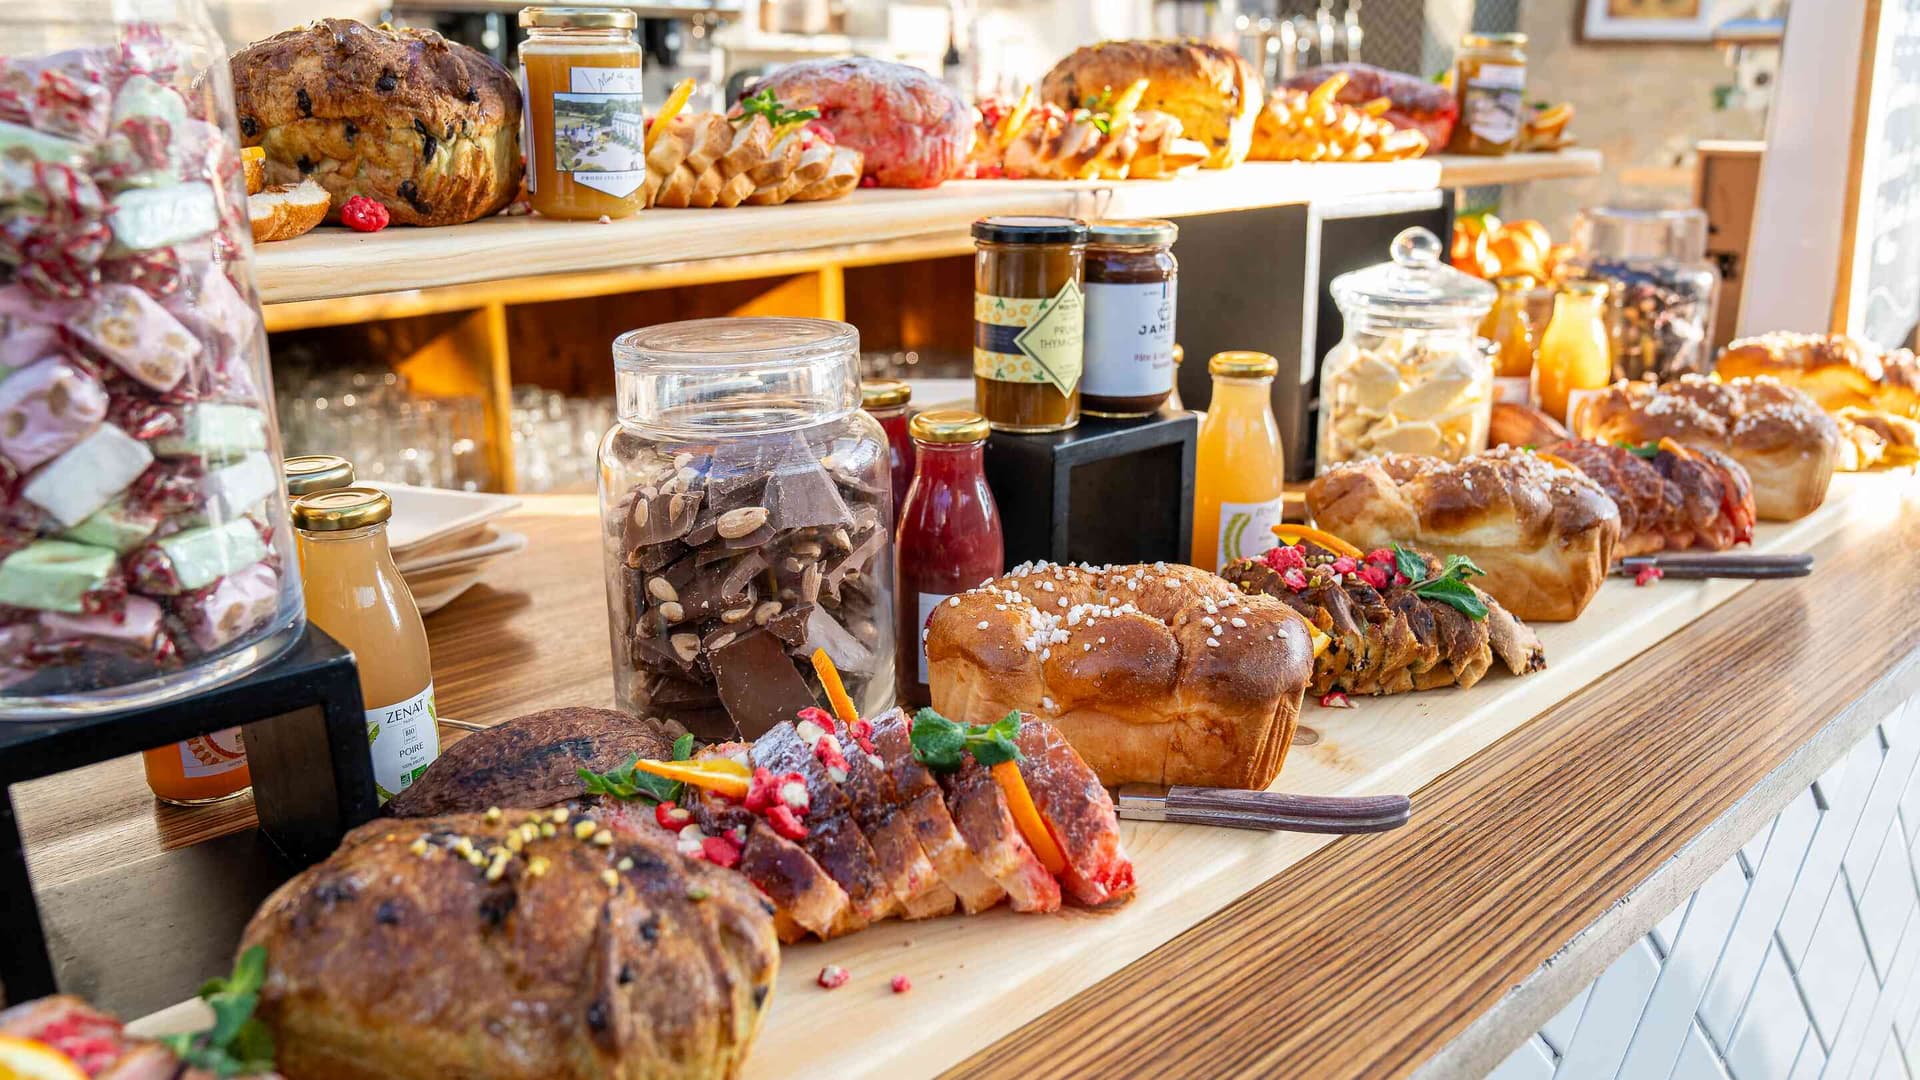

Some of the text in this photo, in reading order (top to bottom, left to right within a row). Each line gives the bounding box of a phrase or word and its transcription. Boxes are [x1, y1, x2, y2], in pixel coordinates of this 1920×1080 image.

[386, 698, 424, 724] ZENAT
[405, 727, 415, 737] BIO
[399, 741, 424, 758] POIRE
